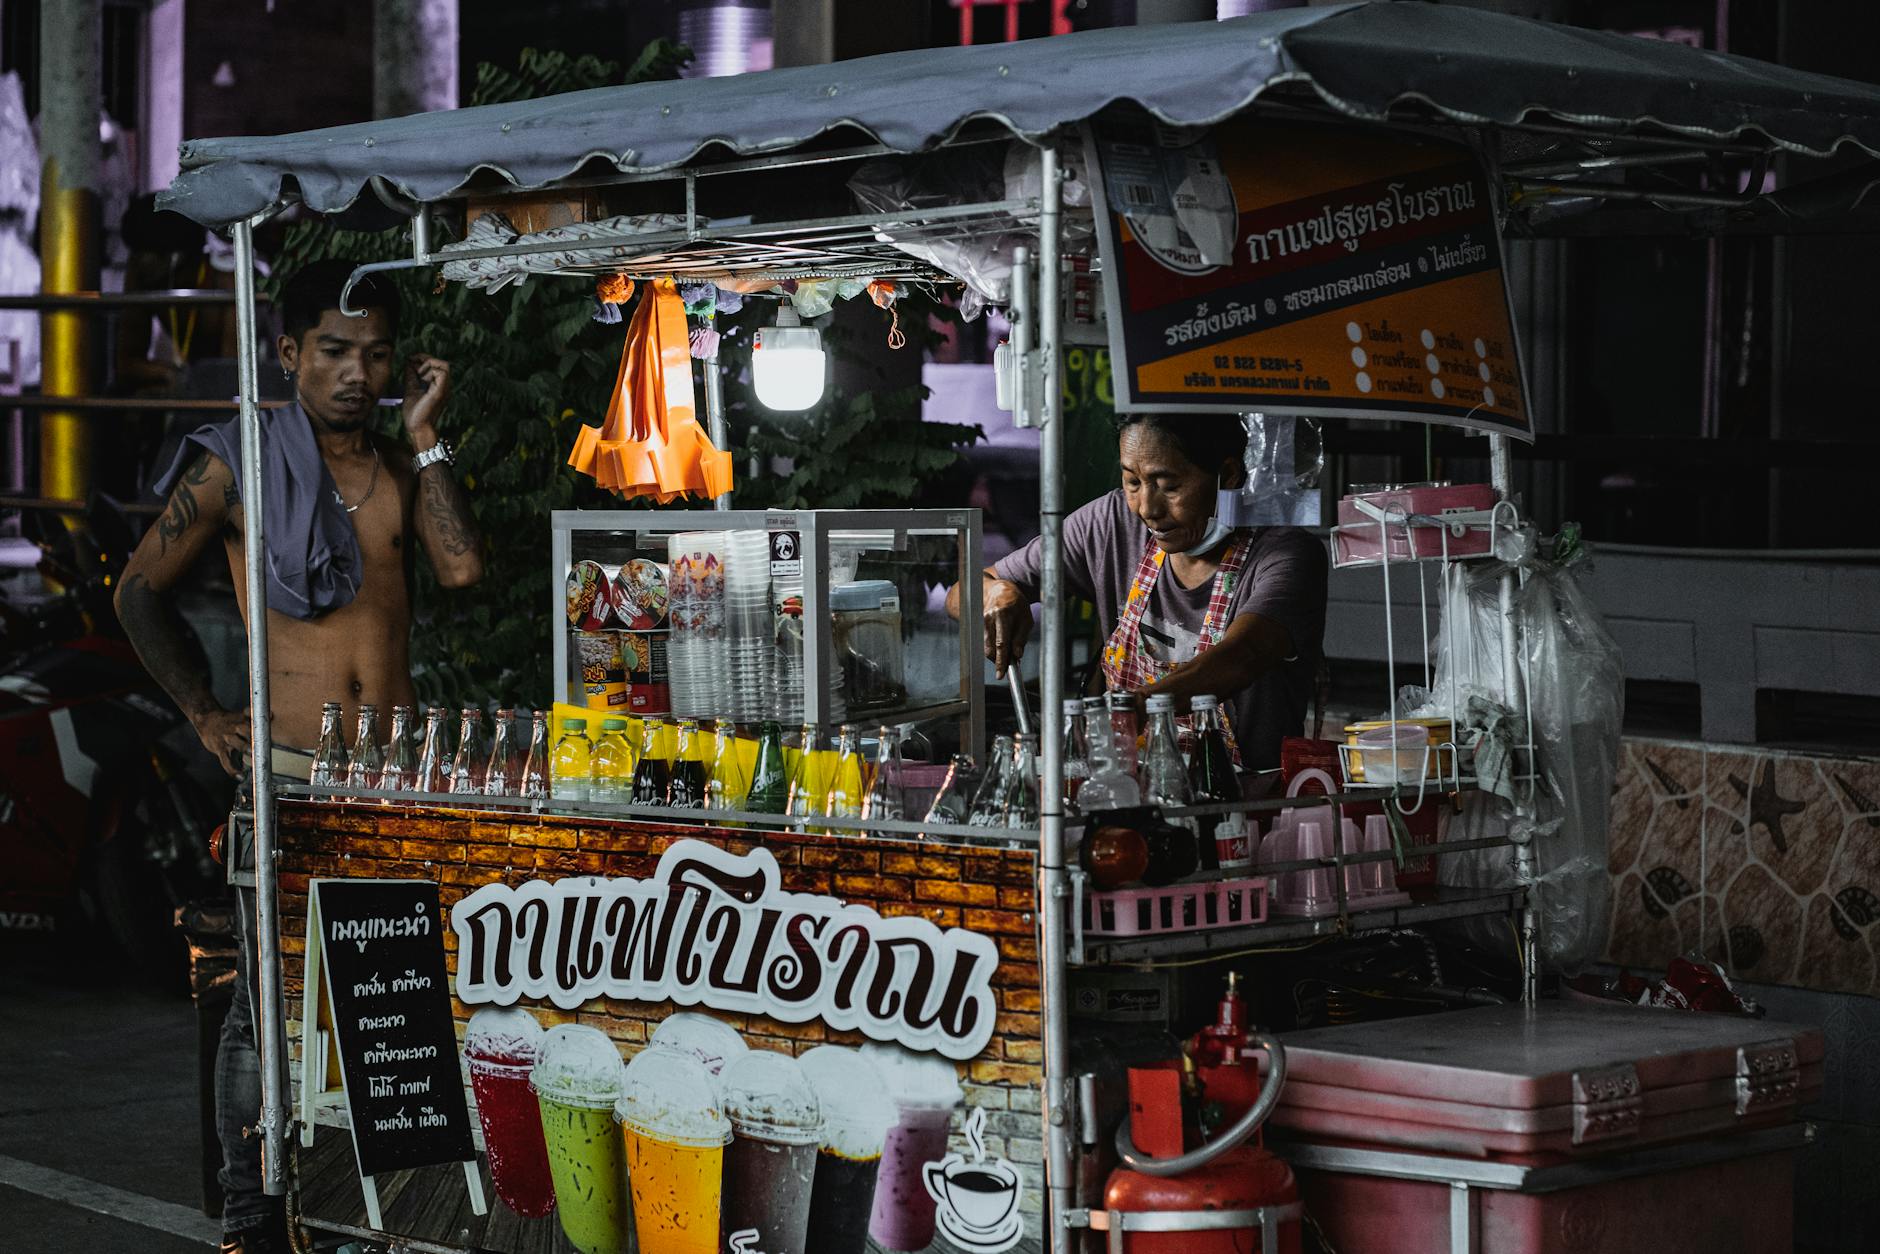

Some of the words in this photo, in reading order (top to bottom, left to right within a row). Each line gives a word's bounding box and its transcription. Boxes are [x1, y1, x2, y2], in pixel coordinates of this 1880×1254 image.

[1246, 181, 1475, 264] กาแฟสูตรโบราณ
[1165, 302, 1257, 346] รสดั้งเดิม
[1283, 256, 1411, 311] หอมกลมกล่อม
[331, 901, 430, 953] เมนูแนะนำ
[465, 857, 981, 1039] กาแฟโบราณ
[353, 971, 387, 998] ชาเย็น
[391, 969, 431, 993] ชาเขียว
[358, 1014, 406, 1032] ชามะนาว
[363, 1041, 437, 1065] ชาเขียวมะนาว
[368, 1075, 399, 1098] โกโก้
[399, 1075, 431, 1096] กาแฟ
[374, 1106, 413, 1131] นมเย็น
[419, 1106, 449, 1129] เผือก
